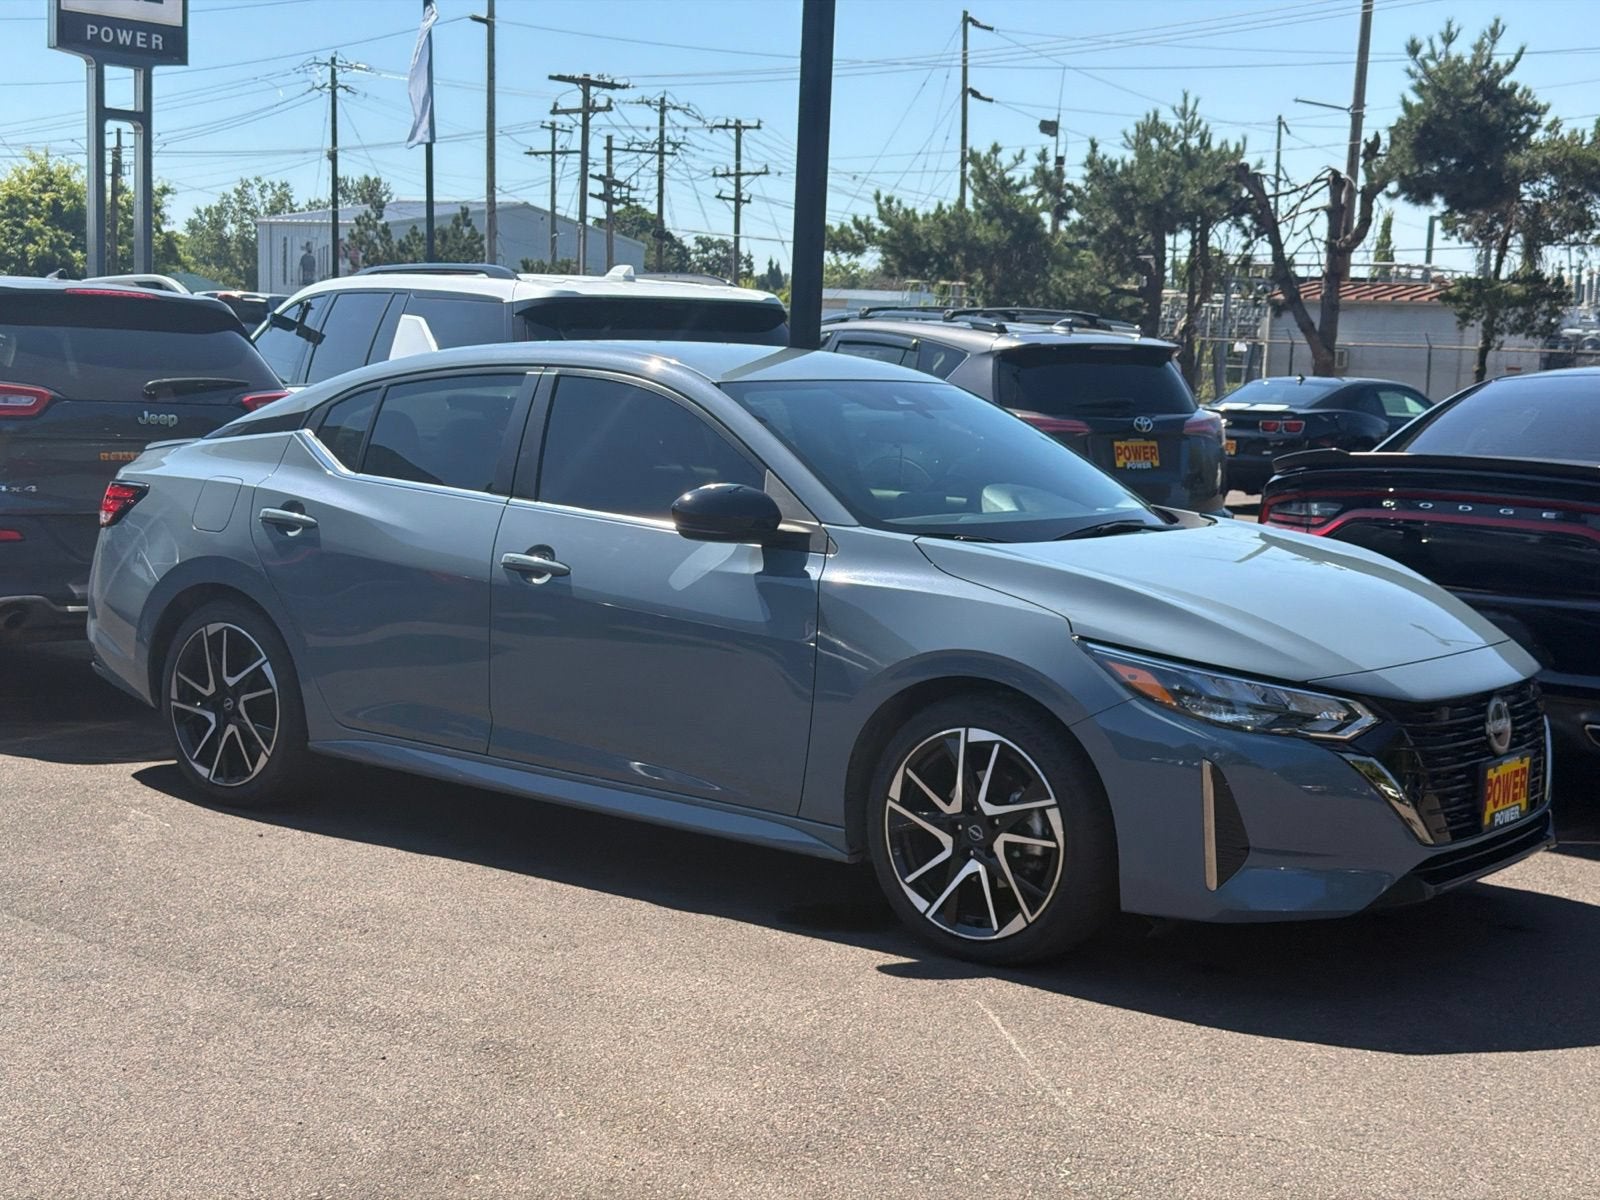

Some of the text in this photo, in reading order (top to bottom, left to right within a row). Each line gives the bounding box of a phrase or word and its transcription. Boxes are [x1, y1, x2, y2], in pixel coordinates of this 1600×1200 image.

[87, 24, 163, 50] POWER
[138, 410, 178, 426] Jeep
[1116, 445, 1158, 461] POWER
[1126, 462, 1152, 470] POWER
[1487, 767, 1527, 809] POWER
[1494, 806, 1520, 826] POWER
